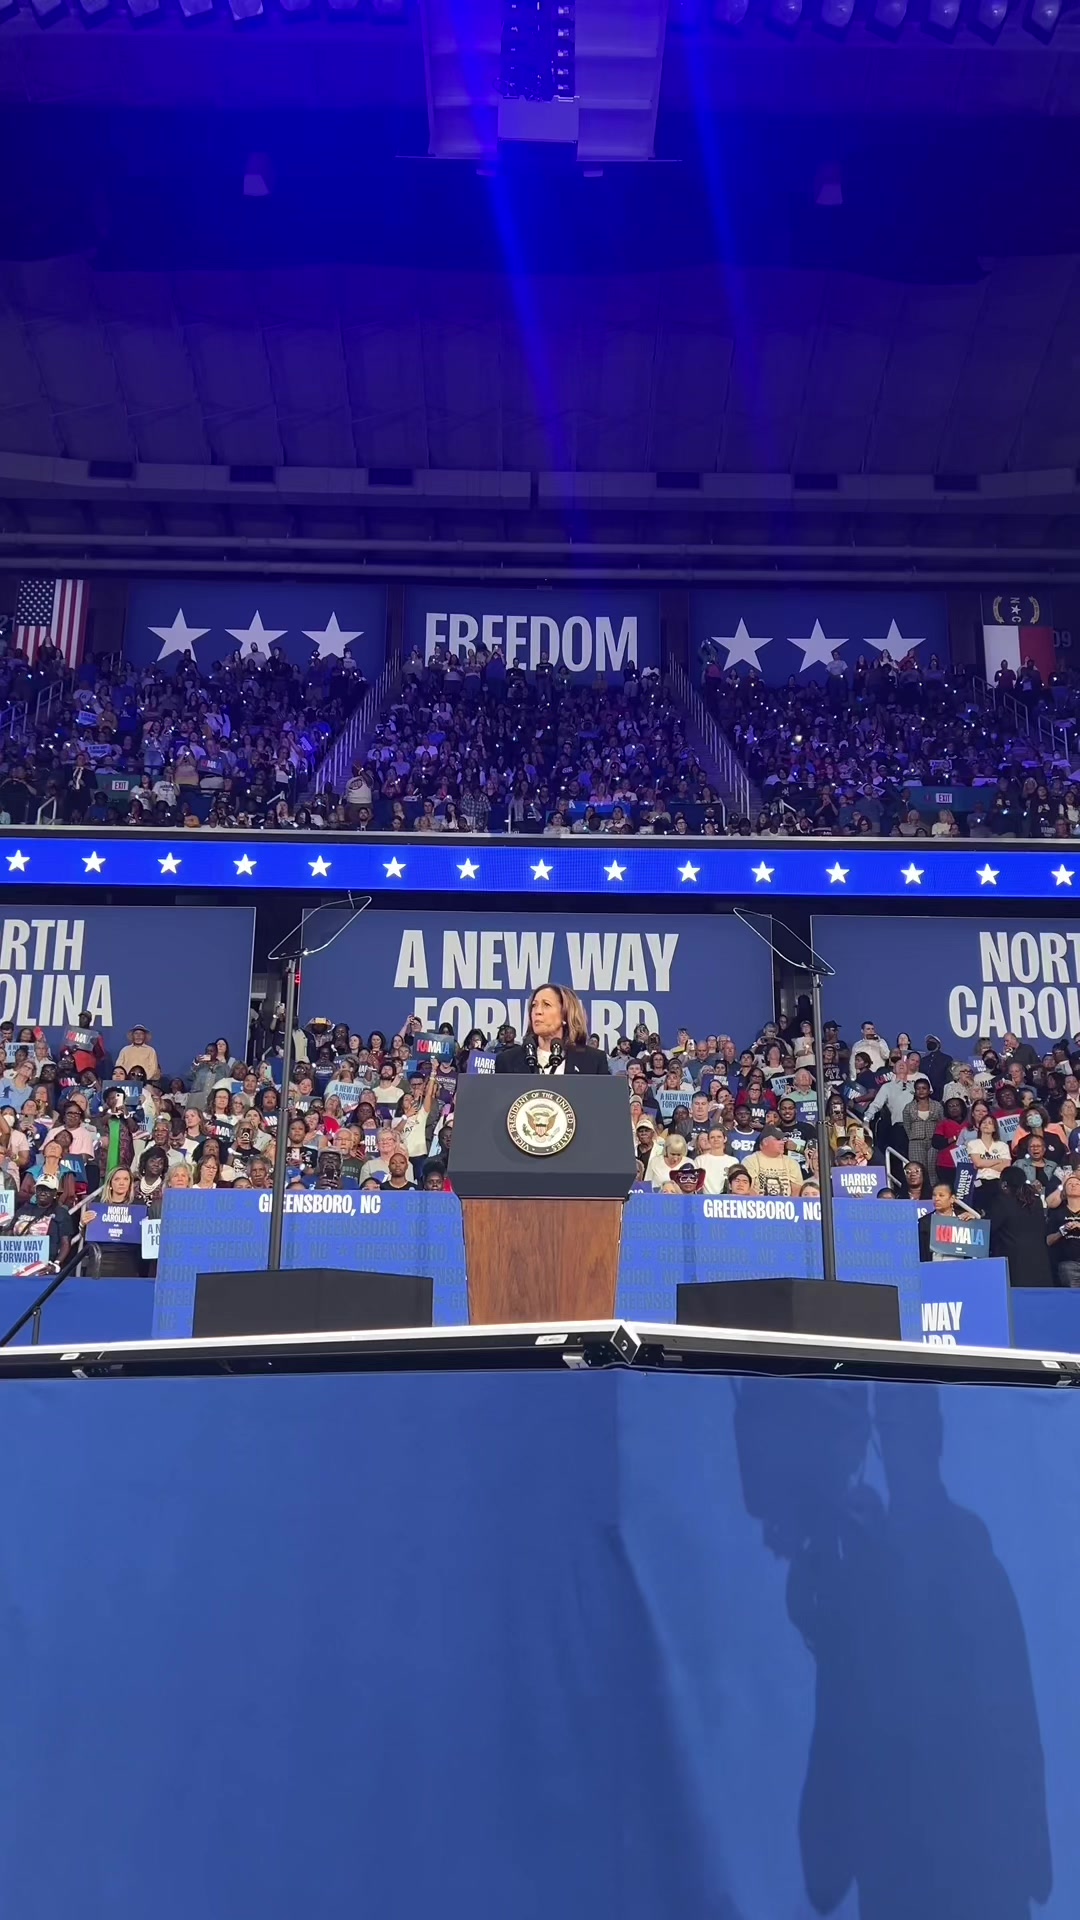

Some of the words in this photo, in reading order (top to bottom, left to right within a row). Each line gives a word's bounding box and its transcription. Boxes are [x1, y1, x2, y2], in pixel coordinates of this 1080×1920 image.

[114, 781, 127, 790] EXIT
[393, 930, 429, 989] A
[441, 930, 555, 990] NEW
[566, 932, 680, 992] WAY
[413, 996, 659, 1056] FORRD
[416, 1039, 450, 1055] KAMALA
[474, 1057, 496, 1069] HARR
[666, 1093, 678, 1101] NEW
[508, 1094, 529, 1133] PRESIDENT
[556, 1097, 574, 1124] UNITED
[551, 1128, 573, 1152] STATES
[841, 1173, 877, 1187] HARRIS
[847, 1186, 873, 1194] WALZ
[956, 1169, 970, 1200] HARRIS
[963, 1175, 974, 1196] WALZ
[360, 1195, 381, 1214] NC
[703, 1200, 798, 1223] GREENSBORO,
[102, 1213, 132, 1223] CAROLINA
[3, 1240, 23, 1252] NEW
[23, 1240, 43, 1251] WAY
[936, 1225, 985, 1246] KAMALA
[921, 1301, 963, 1332] WAY
